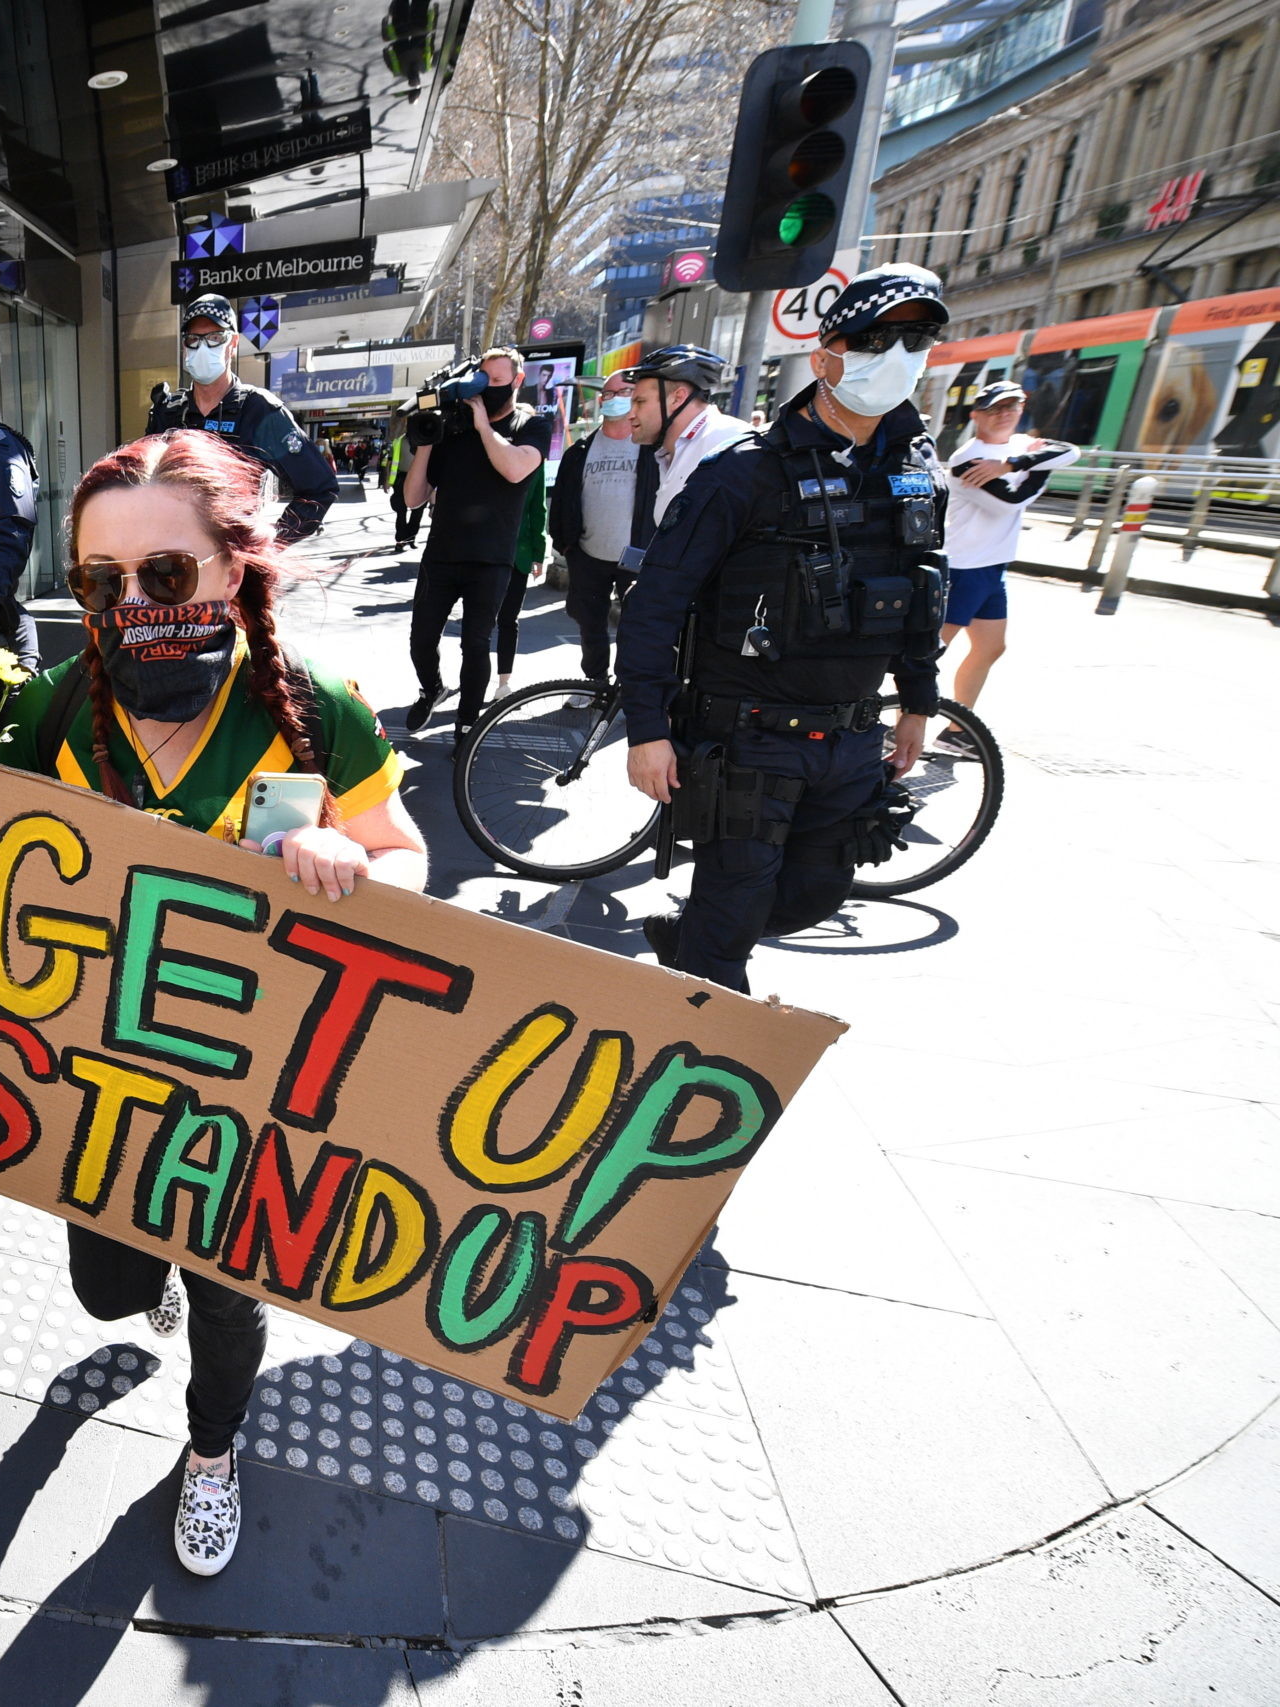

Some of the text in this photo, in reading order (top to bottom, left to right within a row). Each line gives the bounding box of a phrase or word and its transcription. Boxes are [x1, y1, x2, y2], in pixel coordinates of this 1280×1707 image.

[198, 254, 364, 287] Bank of Melbourne
[781, 284, 839, 322] 40
[362, 353, 407, 368] SHIFTING
[305, 372, 368, 395] Lincraft
[585, 459, 637, 478] PORTLAN
[441, 1002, 784, 1253] UP
